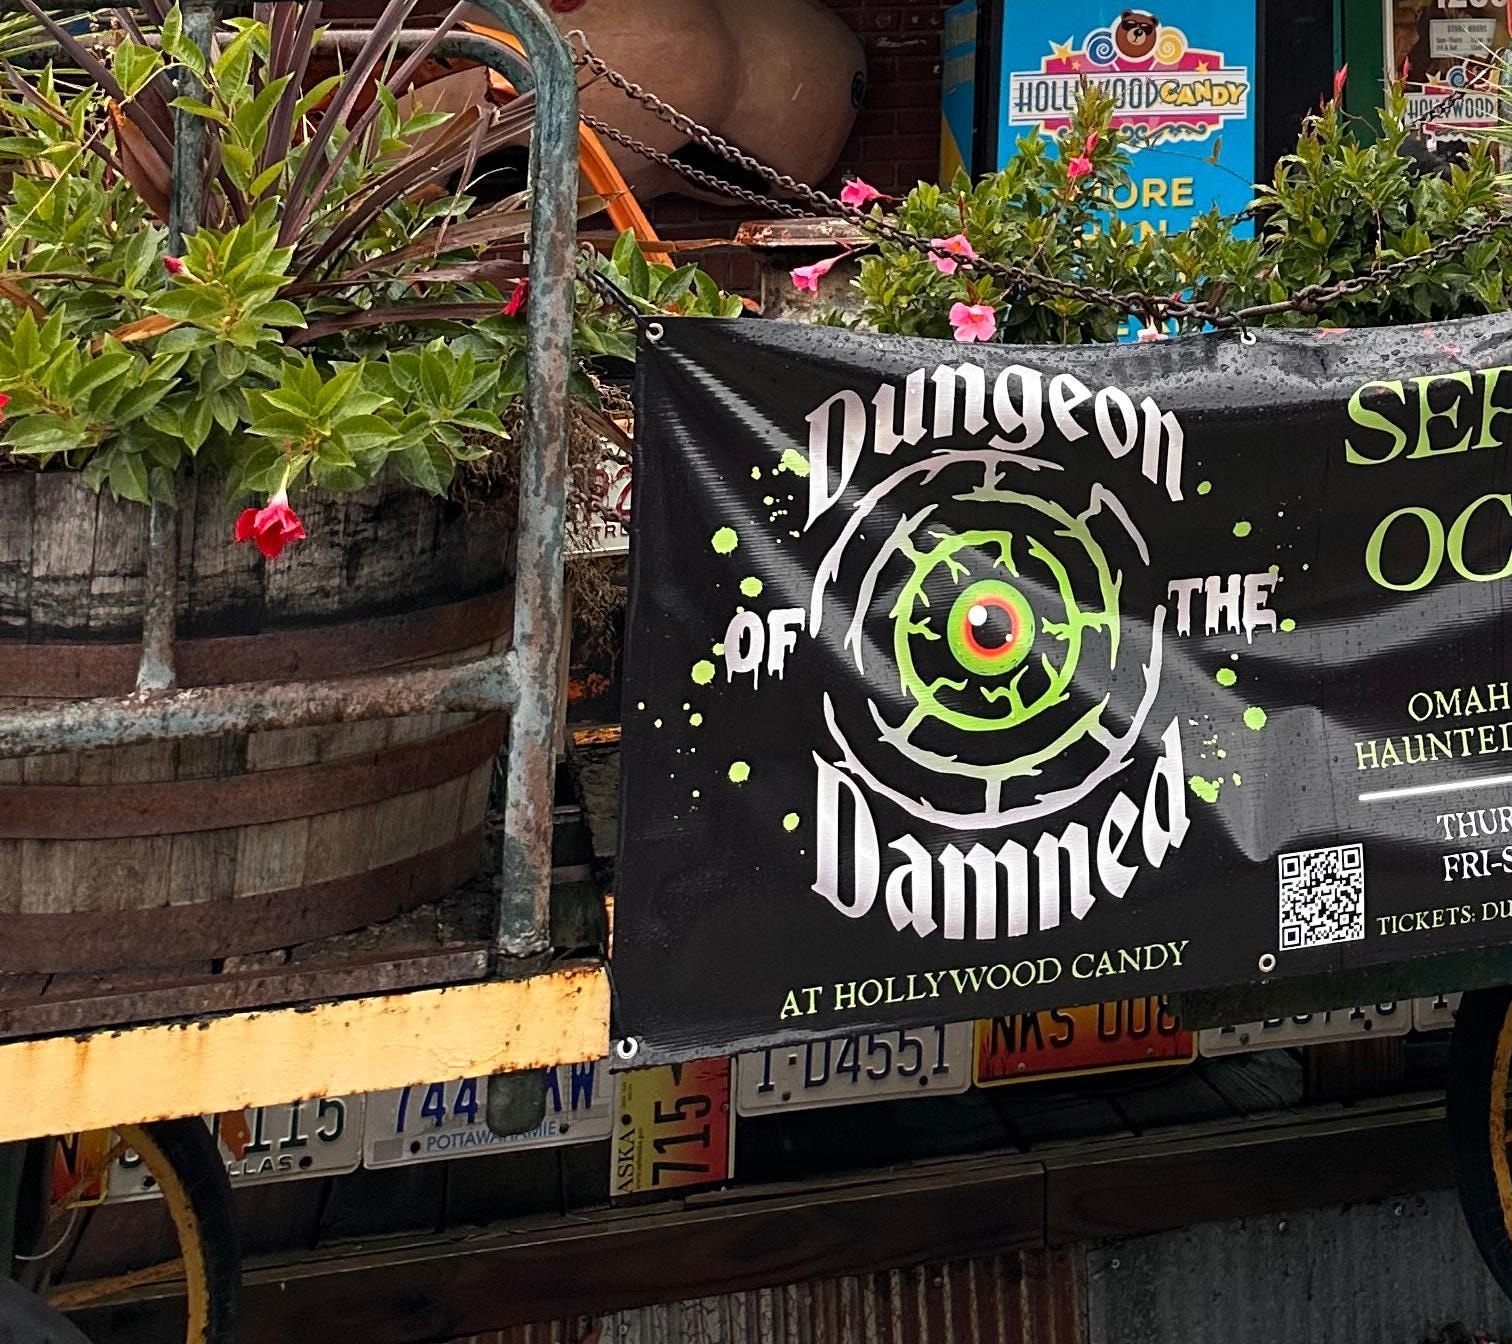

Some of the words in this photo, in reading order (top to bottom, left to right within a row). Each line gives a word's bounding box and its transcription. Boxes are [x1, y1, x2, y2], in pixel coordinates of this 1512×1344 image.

[1159, 78, 1249, 108] CANDY
[803, 362, 1185, 532] Dungeon
[723, 608, 806, 691] OF
[1166, 572, 1278, 644] THE
[811, 716, 1191, 941] Damned
[1376, 908, 1477, 937] TICKETS:
[779, 985, 824, 1022] AT
[834, 957, 1063, 1013] HOLLYWOOD
[1071, 939, 1191, 979] CANDY
